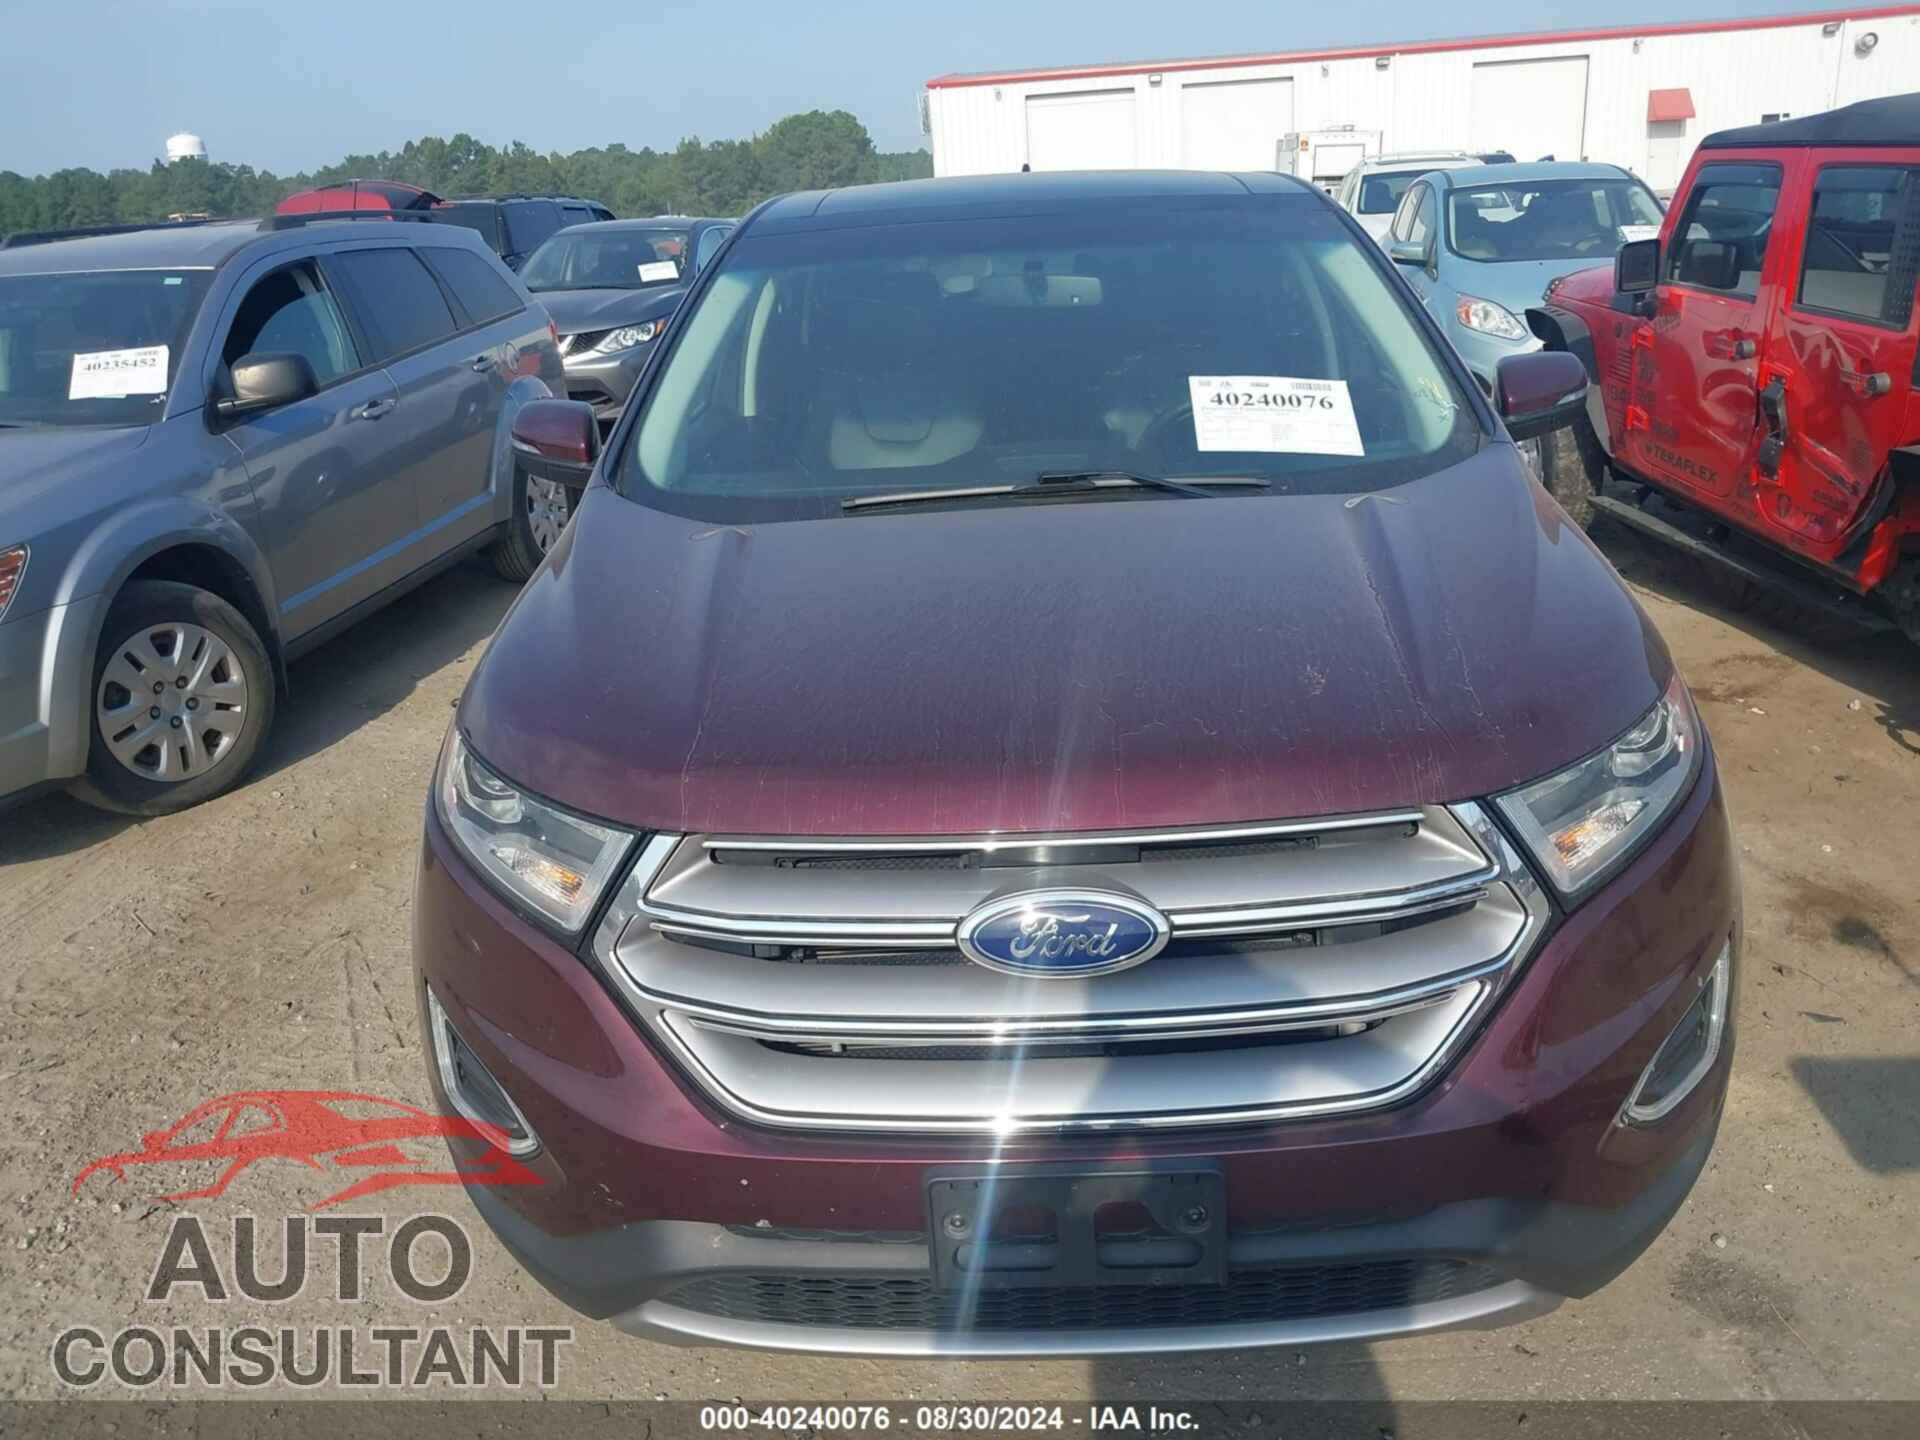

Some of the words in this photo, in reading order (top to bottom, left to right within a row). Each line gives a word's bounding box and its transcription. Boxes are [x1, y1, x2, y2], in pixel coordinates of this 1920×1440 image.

[82, 358, 157, 372] 40235452
[1210, 391, 1334, 410] 40240076
[1010, 911, 1119, 959] Ford
